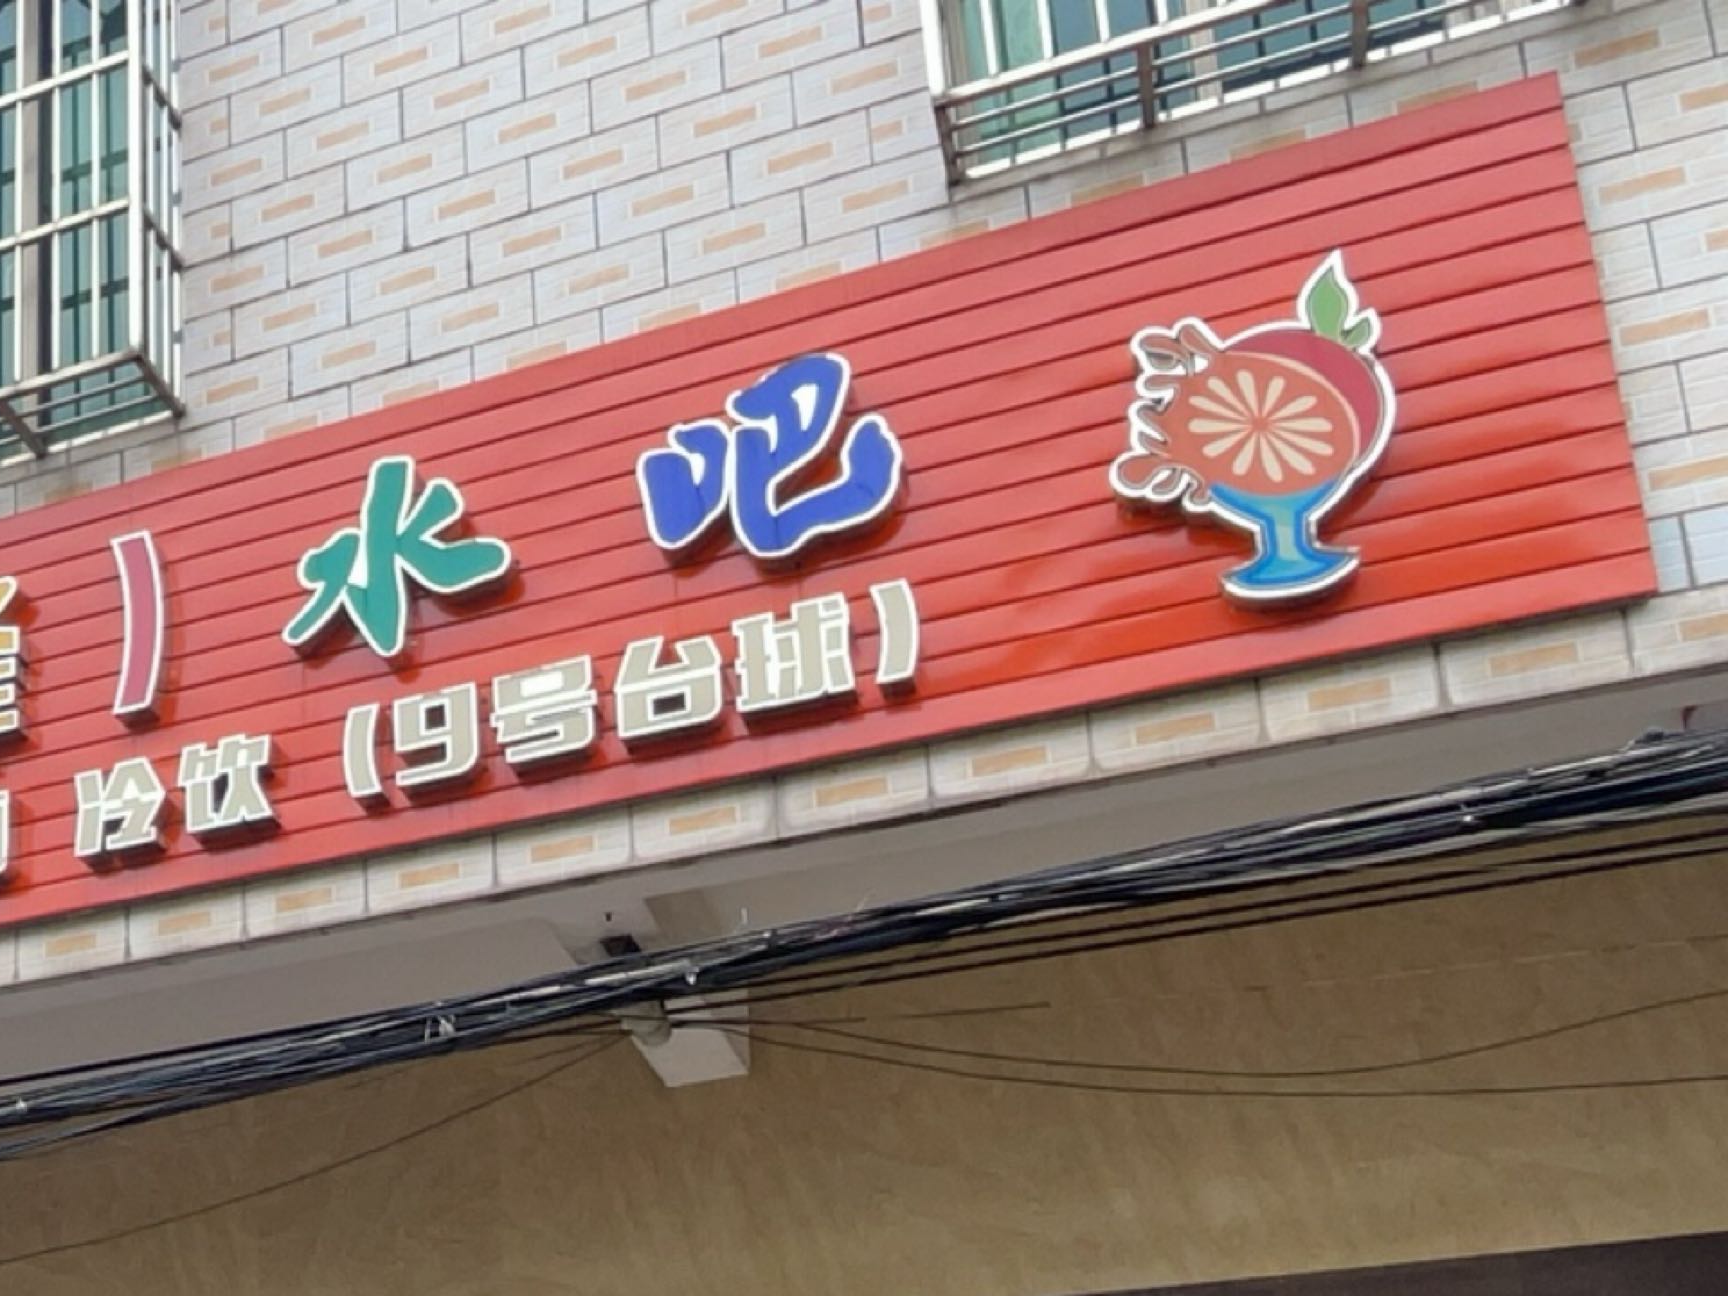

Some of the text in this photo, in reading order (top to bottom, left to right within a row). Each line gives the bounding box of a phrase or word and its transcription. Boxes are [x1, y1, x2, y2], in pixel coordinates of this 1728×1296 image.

[74, 732, 272, 858] 冷饮
[344, 578, 920, 798] (9号台球)
